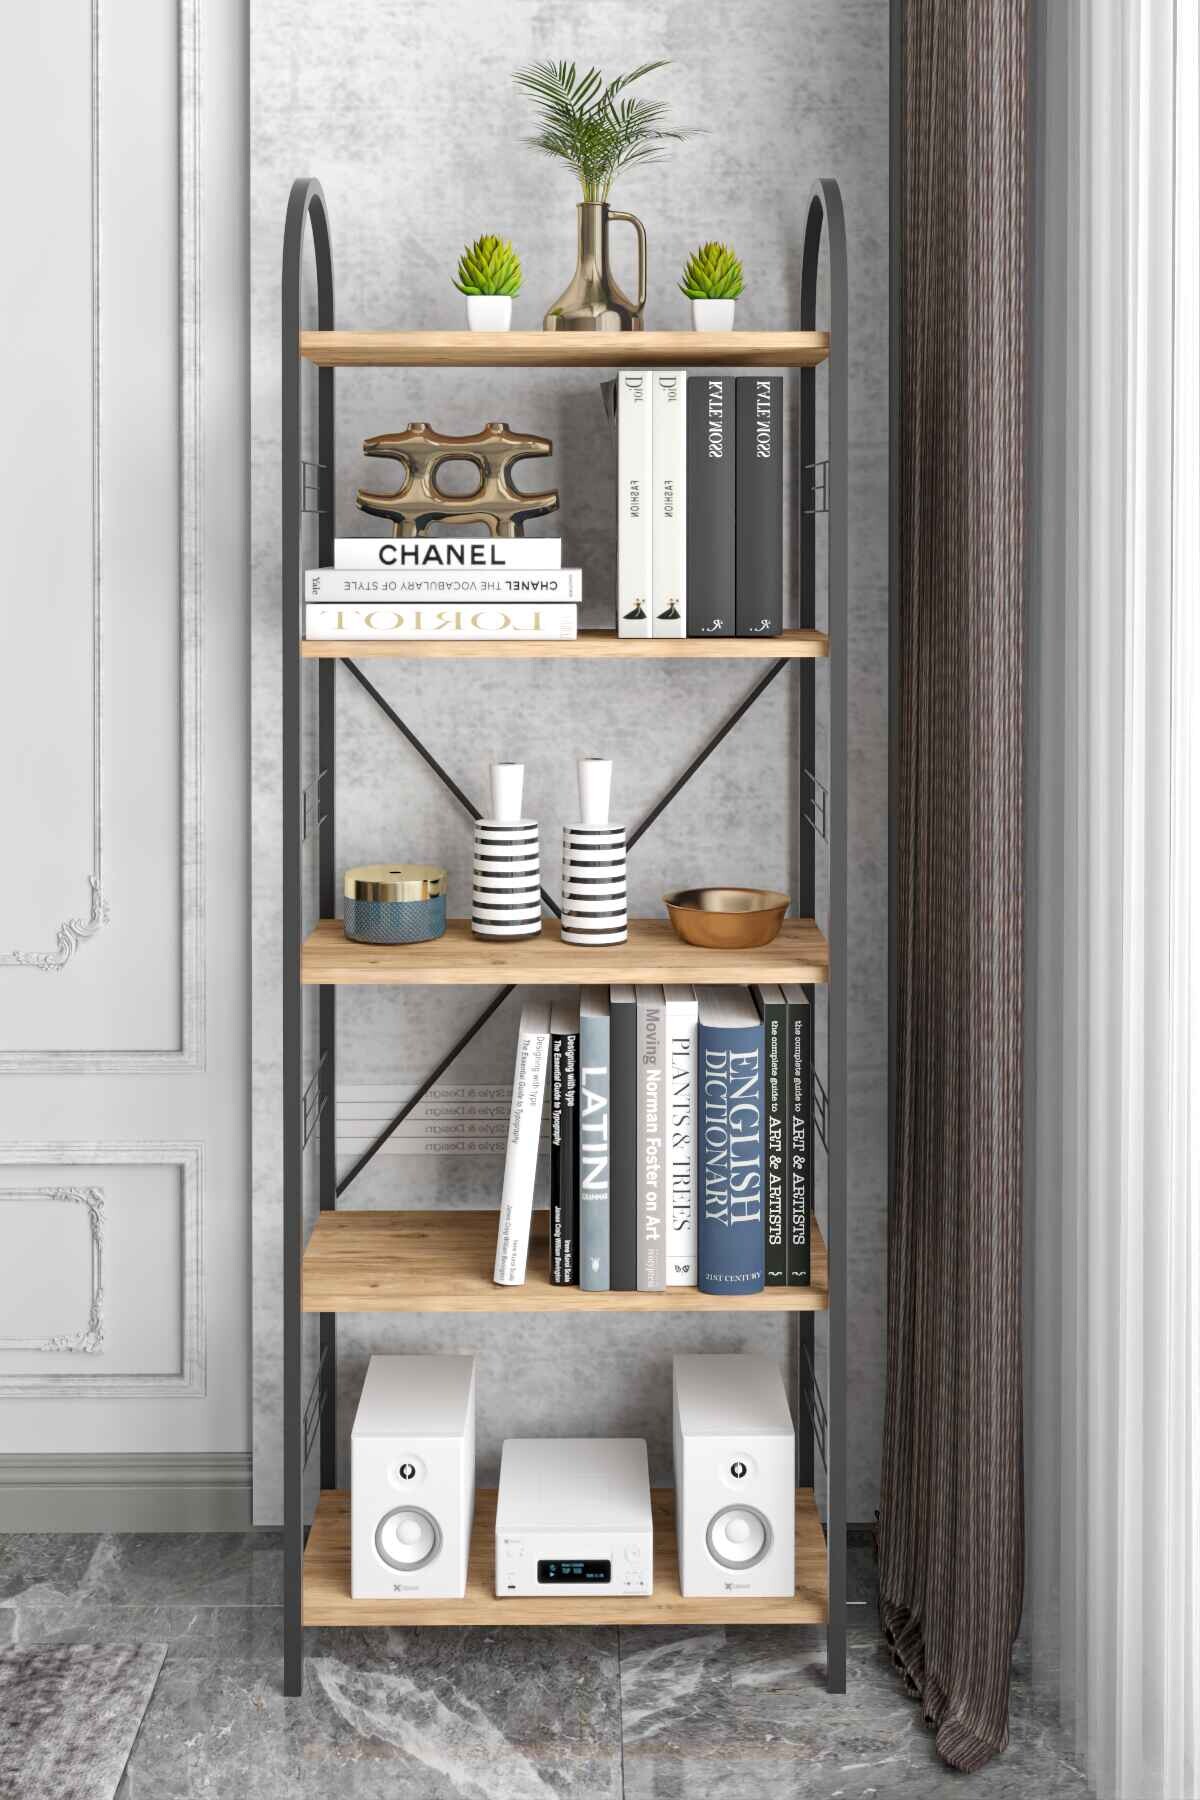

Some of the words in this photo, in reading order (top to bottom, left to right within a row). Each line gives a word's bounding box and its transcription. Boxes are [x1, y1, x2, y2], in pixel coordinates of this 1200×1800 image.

[379, 544, 506, 565] CHANEL
[312, 576, 320, 596] Yale
[344, 581, 378, 591] STYLE
[381, 581, 396, 591] OF
[400, 581, 477, 591] VOCABULARY
[481, 581, 501, 591] THE
[505, 581, 558, 591] CHANEL
[554, 1040, 562, 1052] The
[642, 1008, 660, 1064] Moving
[565, 1035, 576, 1072] Designing
[769, 1036, 778, 1074] complete
[793, 1036, 802, 1074] complete
[554, 1053, 562, 1082] Essential
[518, 1082, 526, 1100] Guide
[532, 1074, 540, 1089] with
[554, 1082, 562, 1101] Guide
[567, 1074, 576, 1090] with
[672, 1038, 691, 1128] PLANTS
[769, 1076, 778, 1100] guide
[793, 1076, 802, 1100] guide
[646, 1070, 662, 1134] Norman
[771, 1102, 778, 1112] to
[795, 1102, 802, 1112] to
[552, 1110, 562, 1146] Typography
[582, 1067, 608, 1191] LATIN
[672, 1132, 690, 1148] &
[704, 1050, 728, 1228] DICTIONARY
[729, 1048, 760, 1224] ENGLISH
[769, 1117, 782, 1150] ART
[793, 1117, 805, 1150] ART
[646, 1138, 662, 1190] Foster
[769, 1154, 782, 1170] &
[793, 1154, 805, 1170] &
[646, 1194, 658, 1210] on
[672, 1152, 691, 1232] TREES
[769, 1174, 782, 1245] ARTISTS
[793, 1174, 806, 1245] ARTISTS
[646, 1214, 662, 1240] Art
